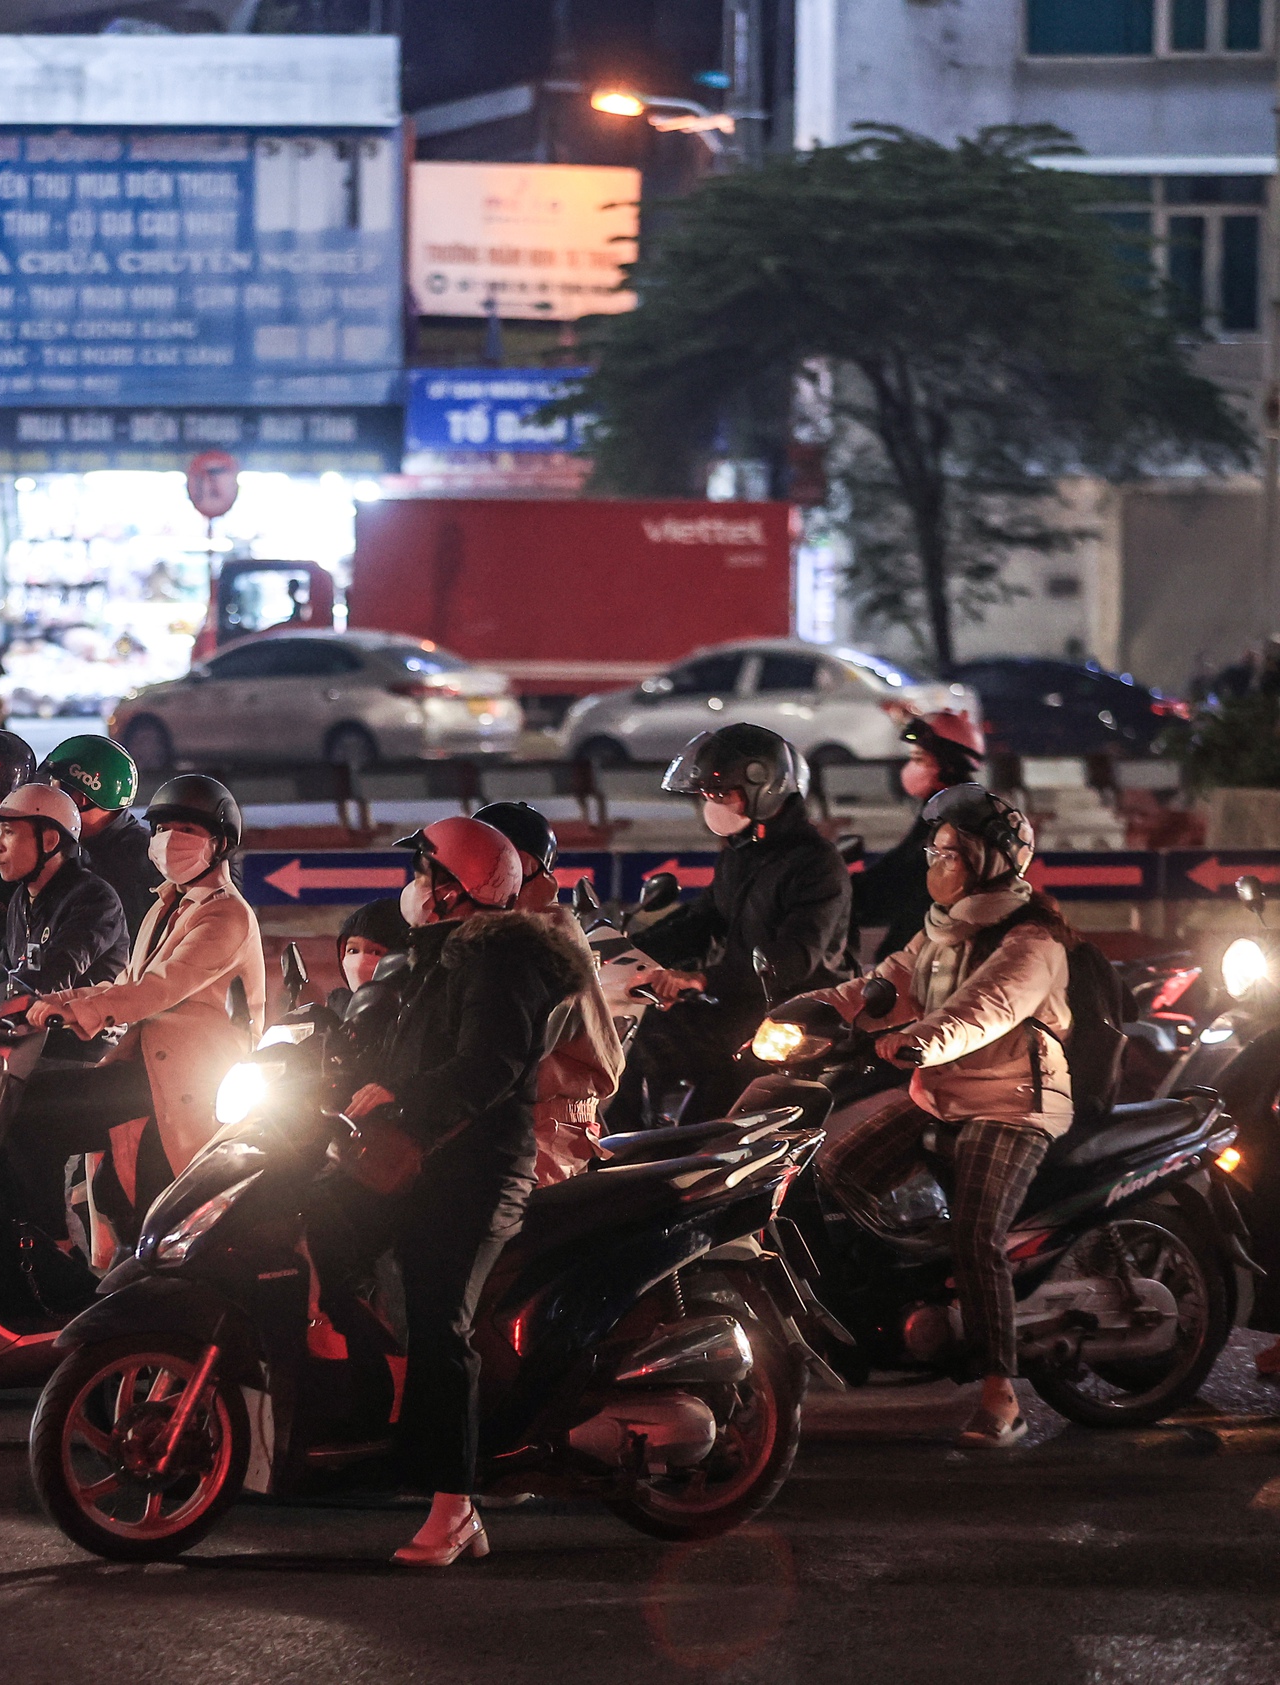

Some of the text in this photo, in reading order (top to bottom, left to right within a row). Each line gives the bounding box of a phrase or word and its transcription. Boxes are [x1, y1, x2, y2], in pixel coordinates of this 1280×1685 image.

[20, 243, 110, 274] CHỮA
[118, 248, 253, 274] CHUYÊN
[641, 516, 765, 547] viettel
[69, 764, 102, 791] Grab
